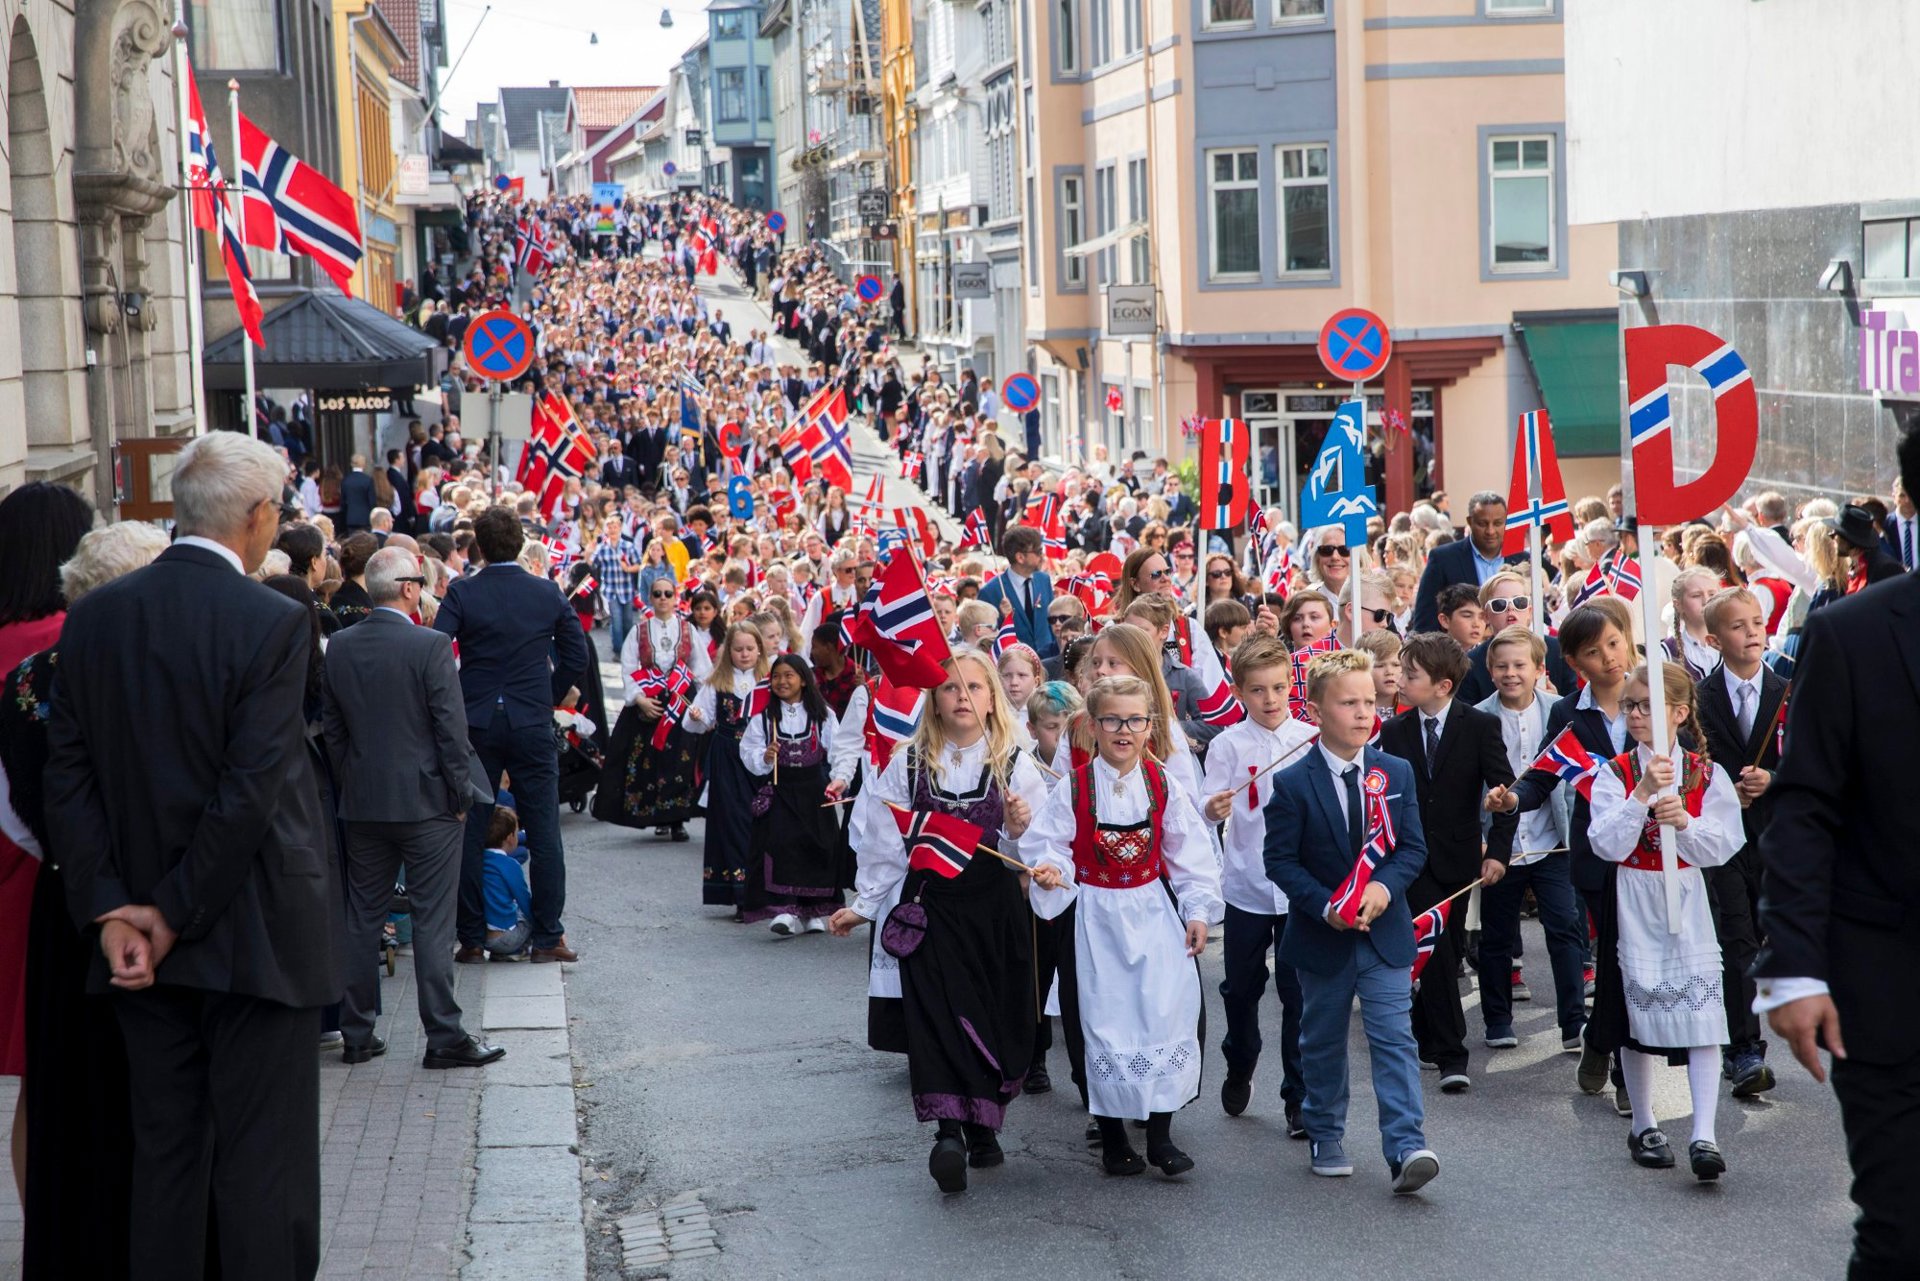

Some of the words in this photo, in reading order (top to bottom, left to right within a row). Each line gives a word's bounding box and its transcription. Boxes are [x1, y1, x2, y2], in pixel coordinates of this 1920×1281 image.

[1112, 307, 1153, 319] EGON
[319, 397, 345, 410] LOS
[346, 396, 390, 410] TACOS
[720, 423, 741, 457] C
[1624, 324, 1759, 526] D
[728, 475, 754, 519] 6
[1200, 418, 1249, 529] B
[1301, 400, 1376, 548] 4
[1502, 409, 1575, 557] A
